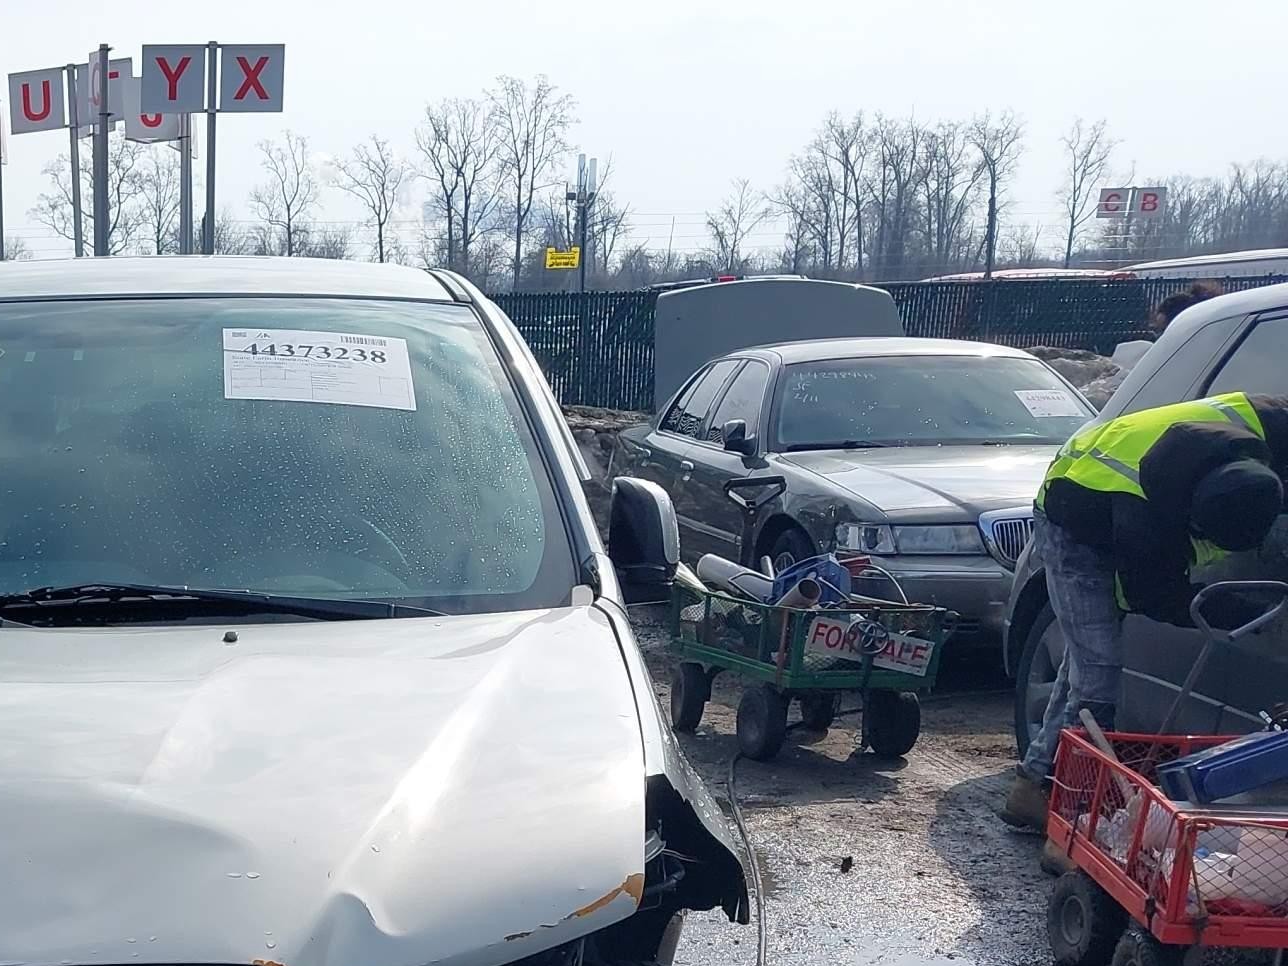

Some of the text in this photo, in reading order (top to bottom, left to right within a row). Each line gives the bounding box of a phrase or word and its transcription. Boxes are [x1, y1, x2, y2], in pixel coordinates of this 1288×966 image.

[156, 57, 269, 100] Y X
[21, 80, 51, 122] U
[1104, 193, 1158, 211] C B
[242, 343, 387, 364] 44373238
[811, 622, 929, 661] FOR ALE
